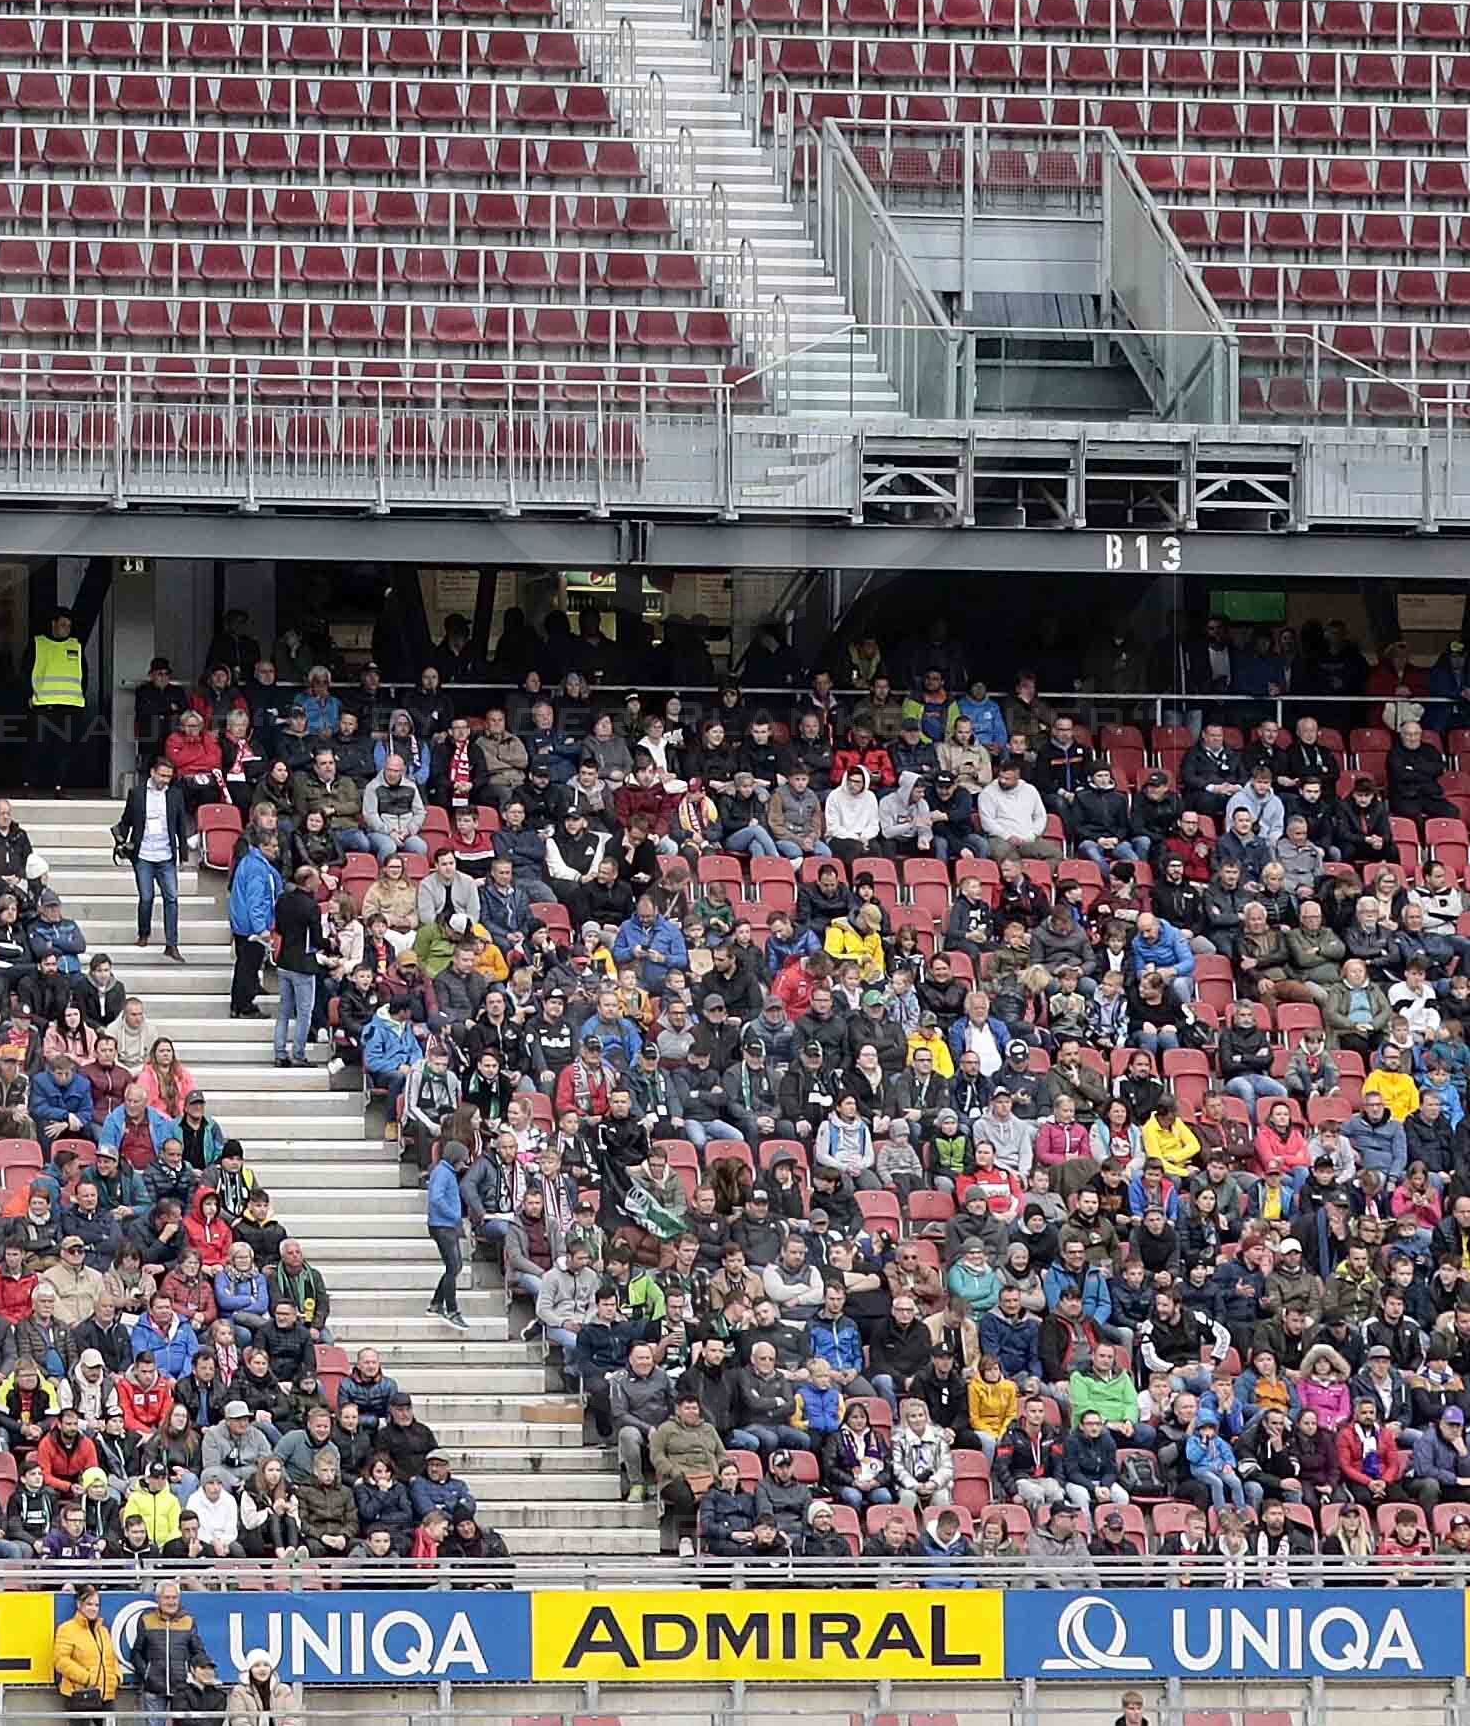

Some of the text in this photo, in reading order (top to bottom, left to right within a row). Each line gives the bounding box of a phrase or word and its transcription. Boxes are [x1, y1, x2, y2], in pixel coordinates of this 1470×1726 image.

[229, 1610, 489, 1676] UNIQA
[564, 1605, 981, 1668] ADMIRAL
[1172, 1606, 1424, 1672] UNIQA
